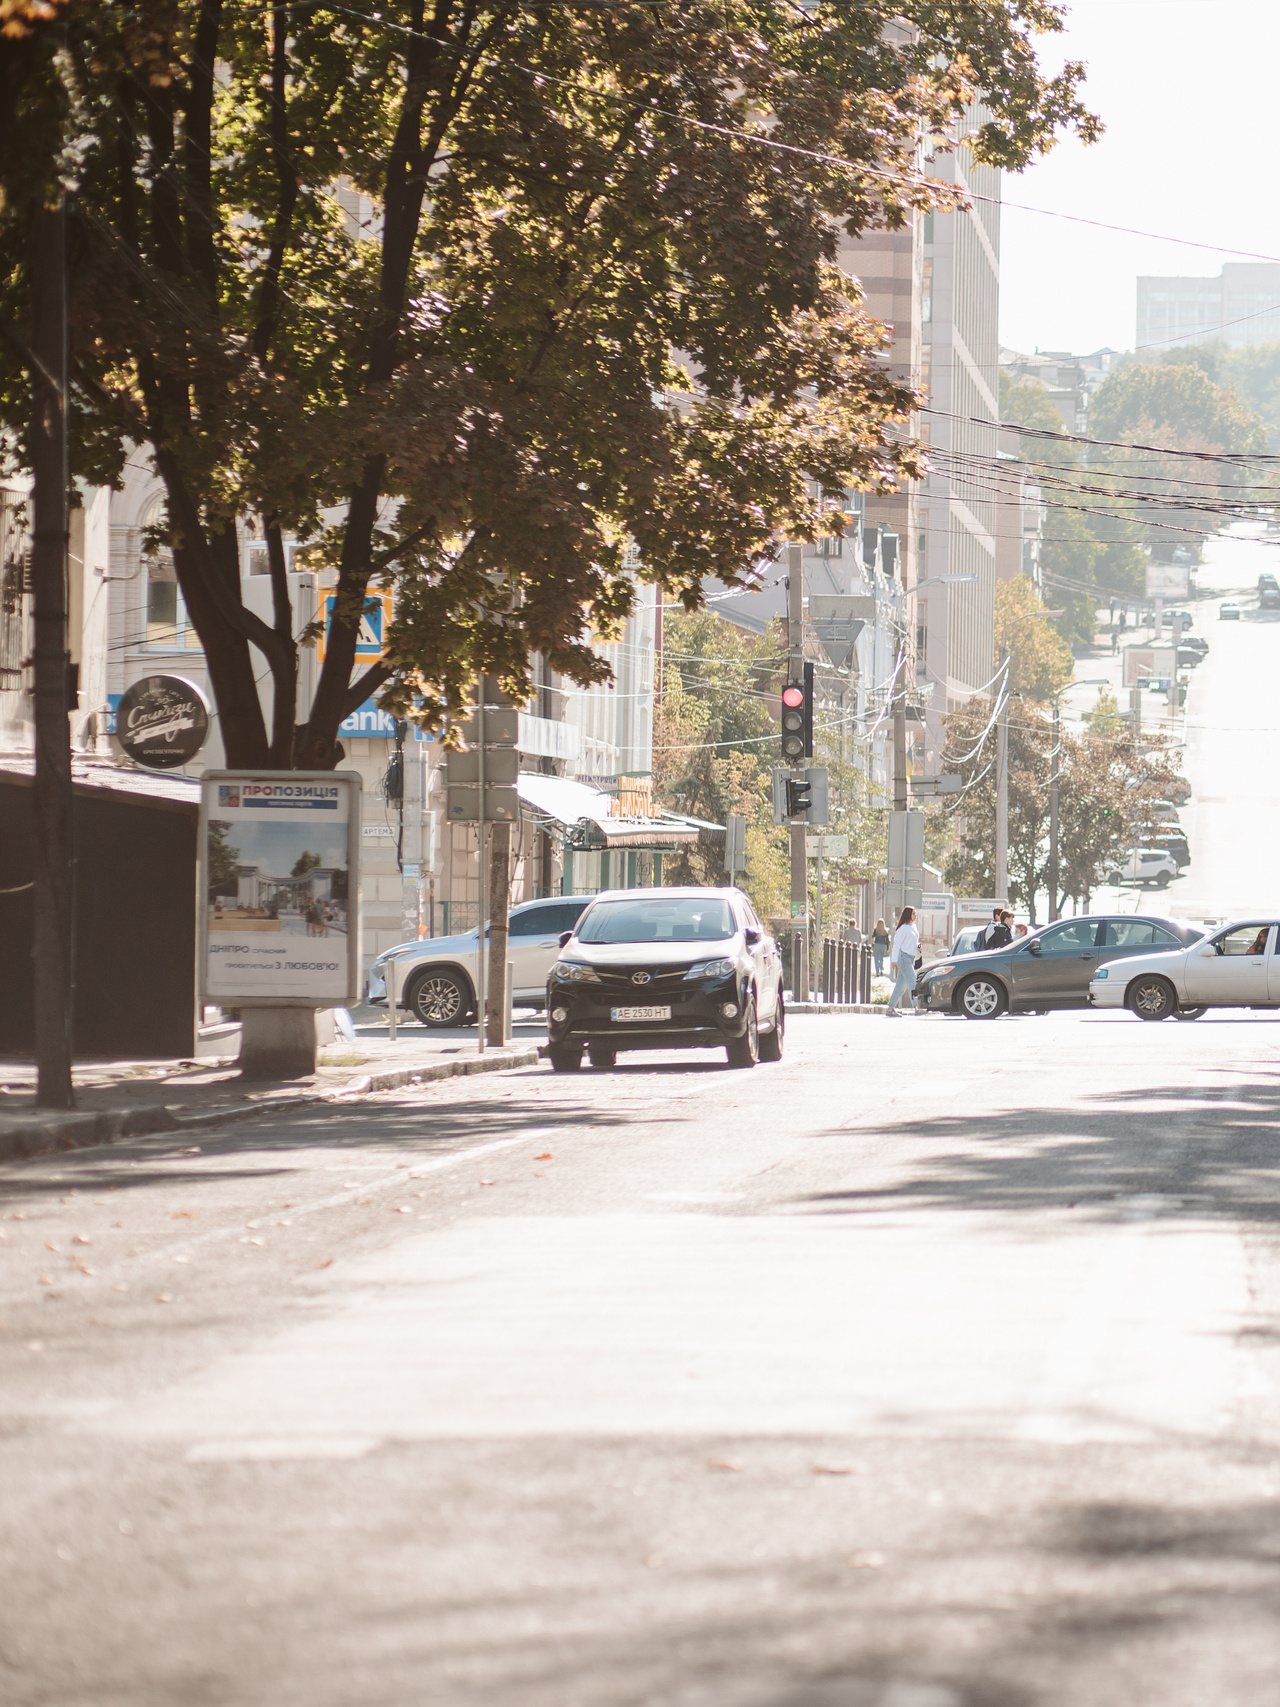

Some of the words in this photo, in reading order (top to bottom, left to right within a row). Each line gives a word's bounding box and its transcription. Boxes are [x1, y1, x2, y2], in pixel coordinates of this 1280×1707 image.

[340, 711, 394, 731] ank
[242, 785, 338, 798] ПРОПОЗИЦІЯ
[209, 944, 249, 954] ДНІПРО
[275, 962, 281, 970] З
[618, 1009, 631, 1018] AE
[632, 1008, 653, 1018] 2530
[655, 1008, 668, 1017] HT
